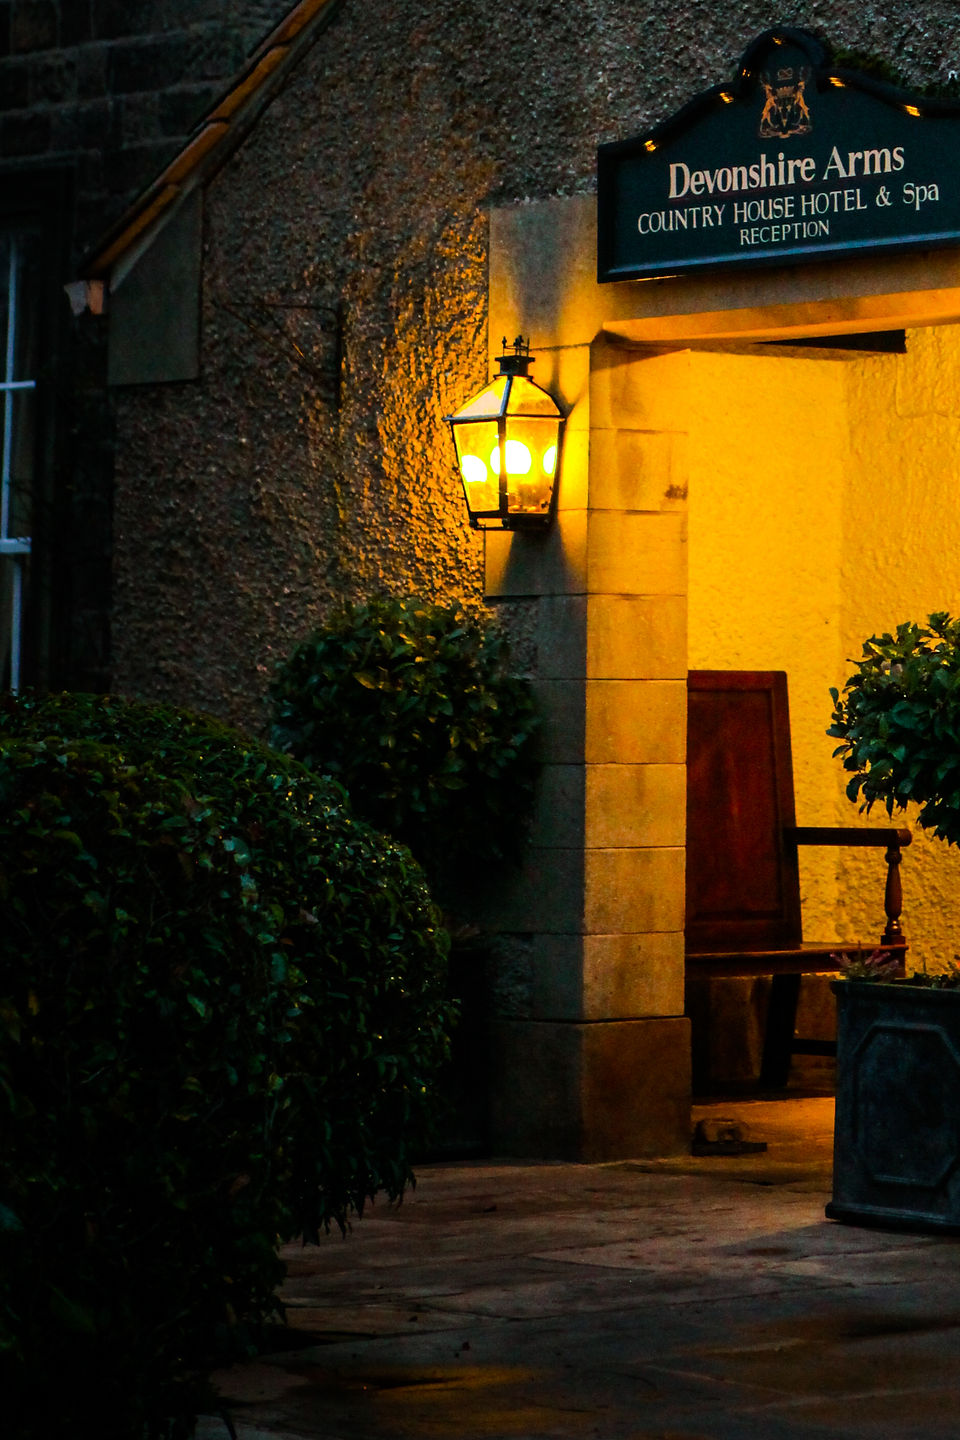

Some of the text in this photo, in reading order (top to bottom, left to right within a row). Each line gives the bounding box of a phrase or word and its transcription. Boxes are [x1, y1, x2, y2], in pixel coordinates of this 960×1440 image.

[668, 145, 905, 199] Devonshire Arms
[637, 182, 940, 235] COUNTRY HOUSE HOTEL & Spa
[739, 219, 830, 246] RECEPTION
